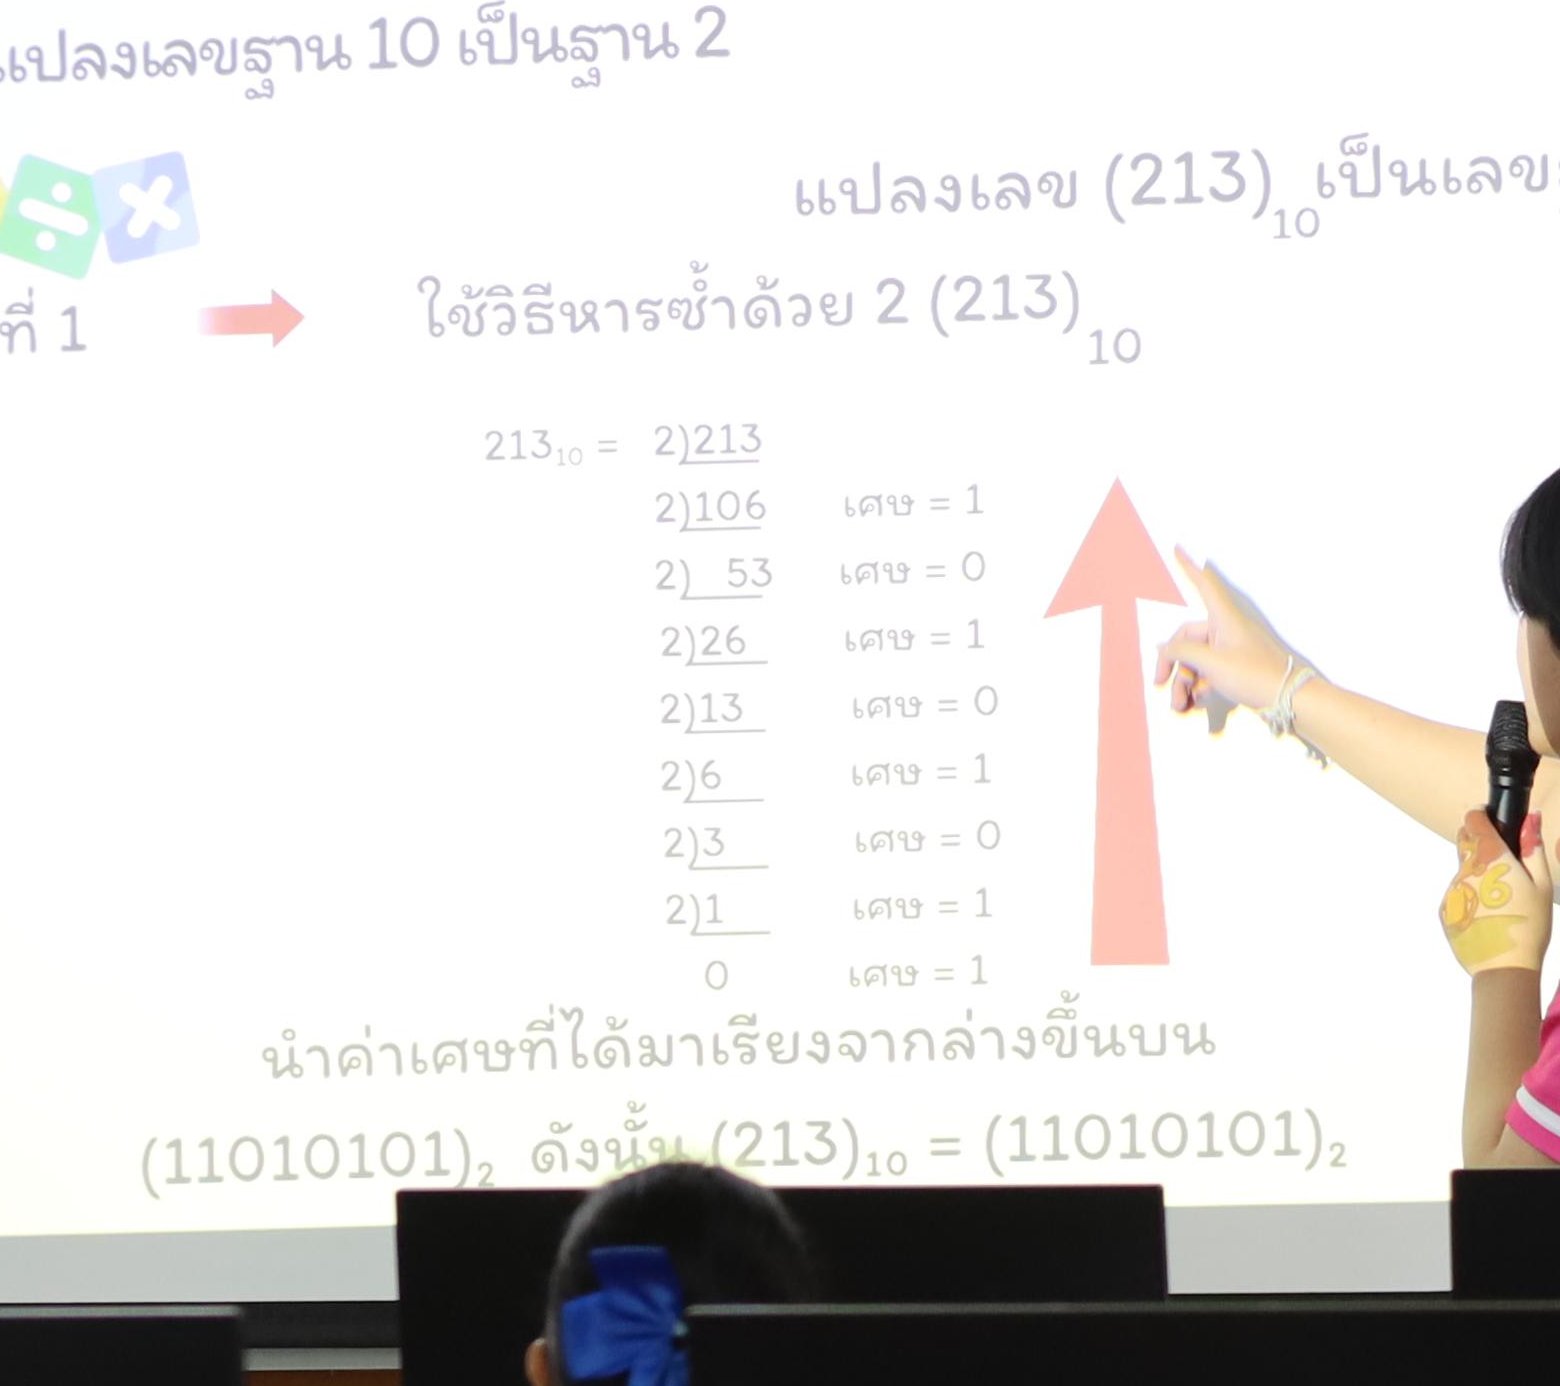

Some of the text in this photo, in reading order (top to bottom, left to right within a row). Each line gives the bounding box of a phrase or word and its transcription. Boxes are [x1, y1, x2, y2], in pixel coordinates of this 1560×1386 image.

[369, 16, 440, 70] 10
[459, 0, 680, 89] เป็นฐาน
[695, 5, 730, 58] 2
[796, 161, 1077, 216] แปลงเลข
[417, 260, 853, 338] ใช้วิธีหารซ้ำด้วย
[876, 278, 909, 324] 2
[61, 306, 87, 352] 1
[845, 494, 914, 517] เศษ
[967, 484, 984, 514] 1
[841, 561, 911, 585] เศษ
[962, 551, 985, 581] 0
[846, 629, 915, 652] เศษ
[968, 619, 984, 648] 1
[853, 696, 923, 719] เศษ
[974, 685, 998, 715] 0
[852, 763, 922, 786] เศษ
[974, 753, 991, 783] 1
[856, 830, 926, 853] เศษ
[977, 820, 1001, 850] 0
[854, 897, 924, 920] เศษ
[976, 887, 992, 917] 1
[705, 960, 728, 991] 0
[850, 964, 919, 988] เศษ
[971, 954, 988, 985] 1
